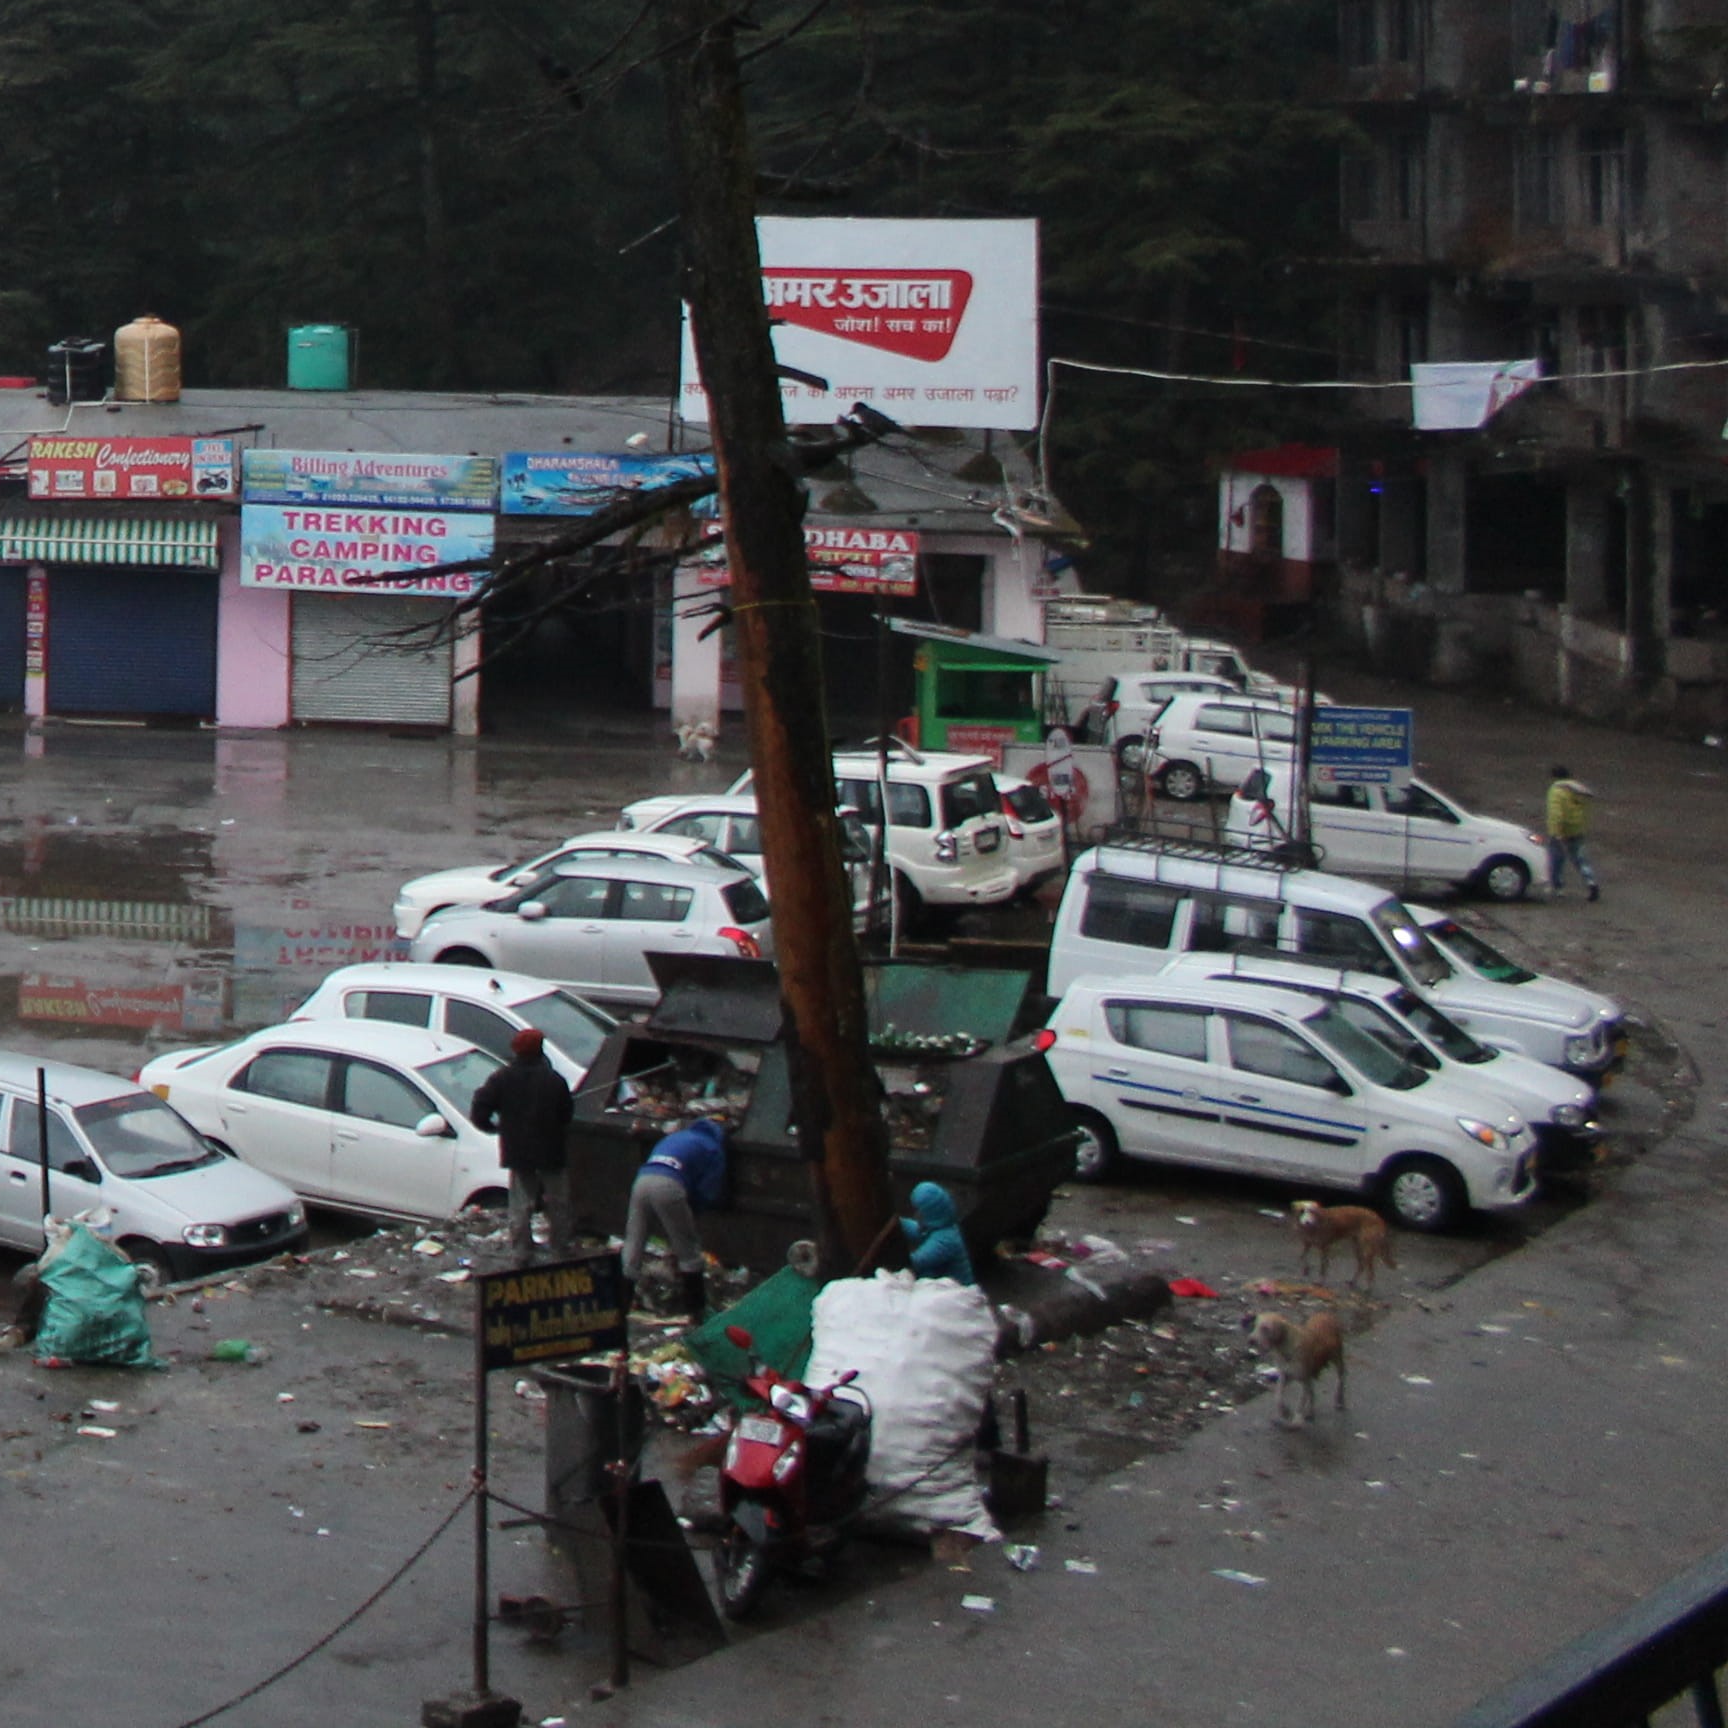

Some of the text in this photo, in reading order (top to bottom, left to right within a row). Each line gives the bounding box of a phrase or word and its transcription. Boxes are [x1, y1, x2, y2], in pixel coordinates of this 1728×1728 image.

[840, 277, 952, 310] उजाला
[834, 385, 874, 401] अपना
[882, 386, 915, 401] अमर
[924, 387, 974, 402] उजाला
[30, 441, 191, 471] RAKESH Confectionery
[291, 456, 349, 476] Billing
[353, 459, 448, 478] Adventures
[526, 457, 619, 470] DHARAMSHALA
[283, 511, 446, 537] TREKKING
[289, 538, 437, 563] CAMPING
[804, 529, 911, 551] DHABA
[486, 1268, 593, 1308] PARKING
